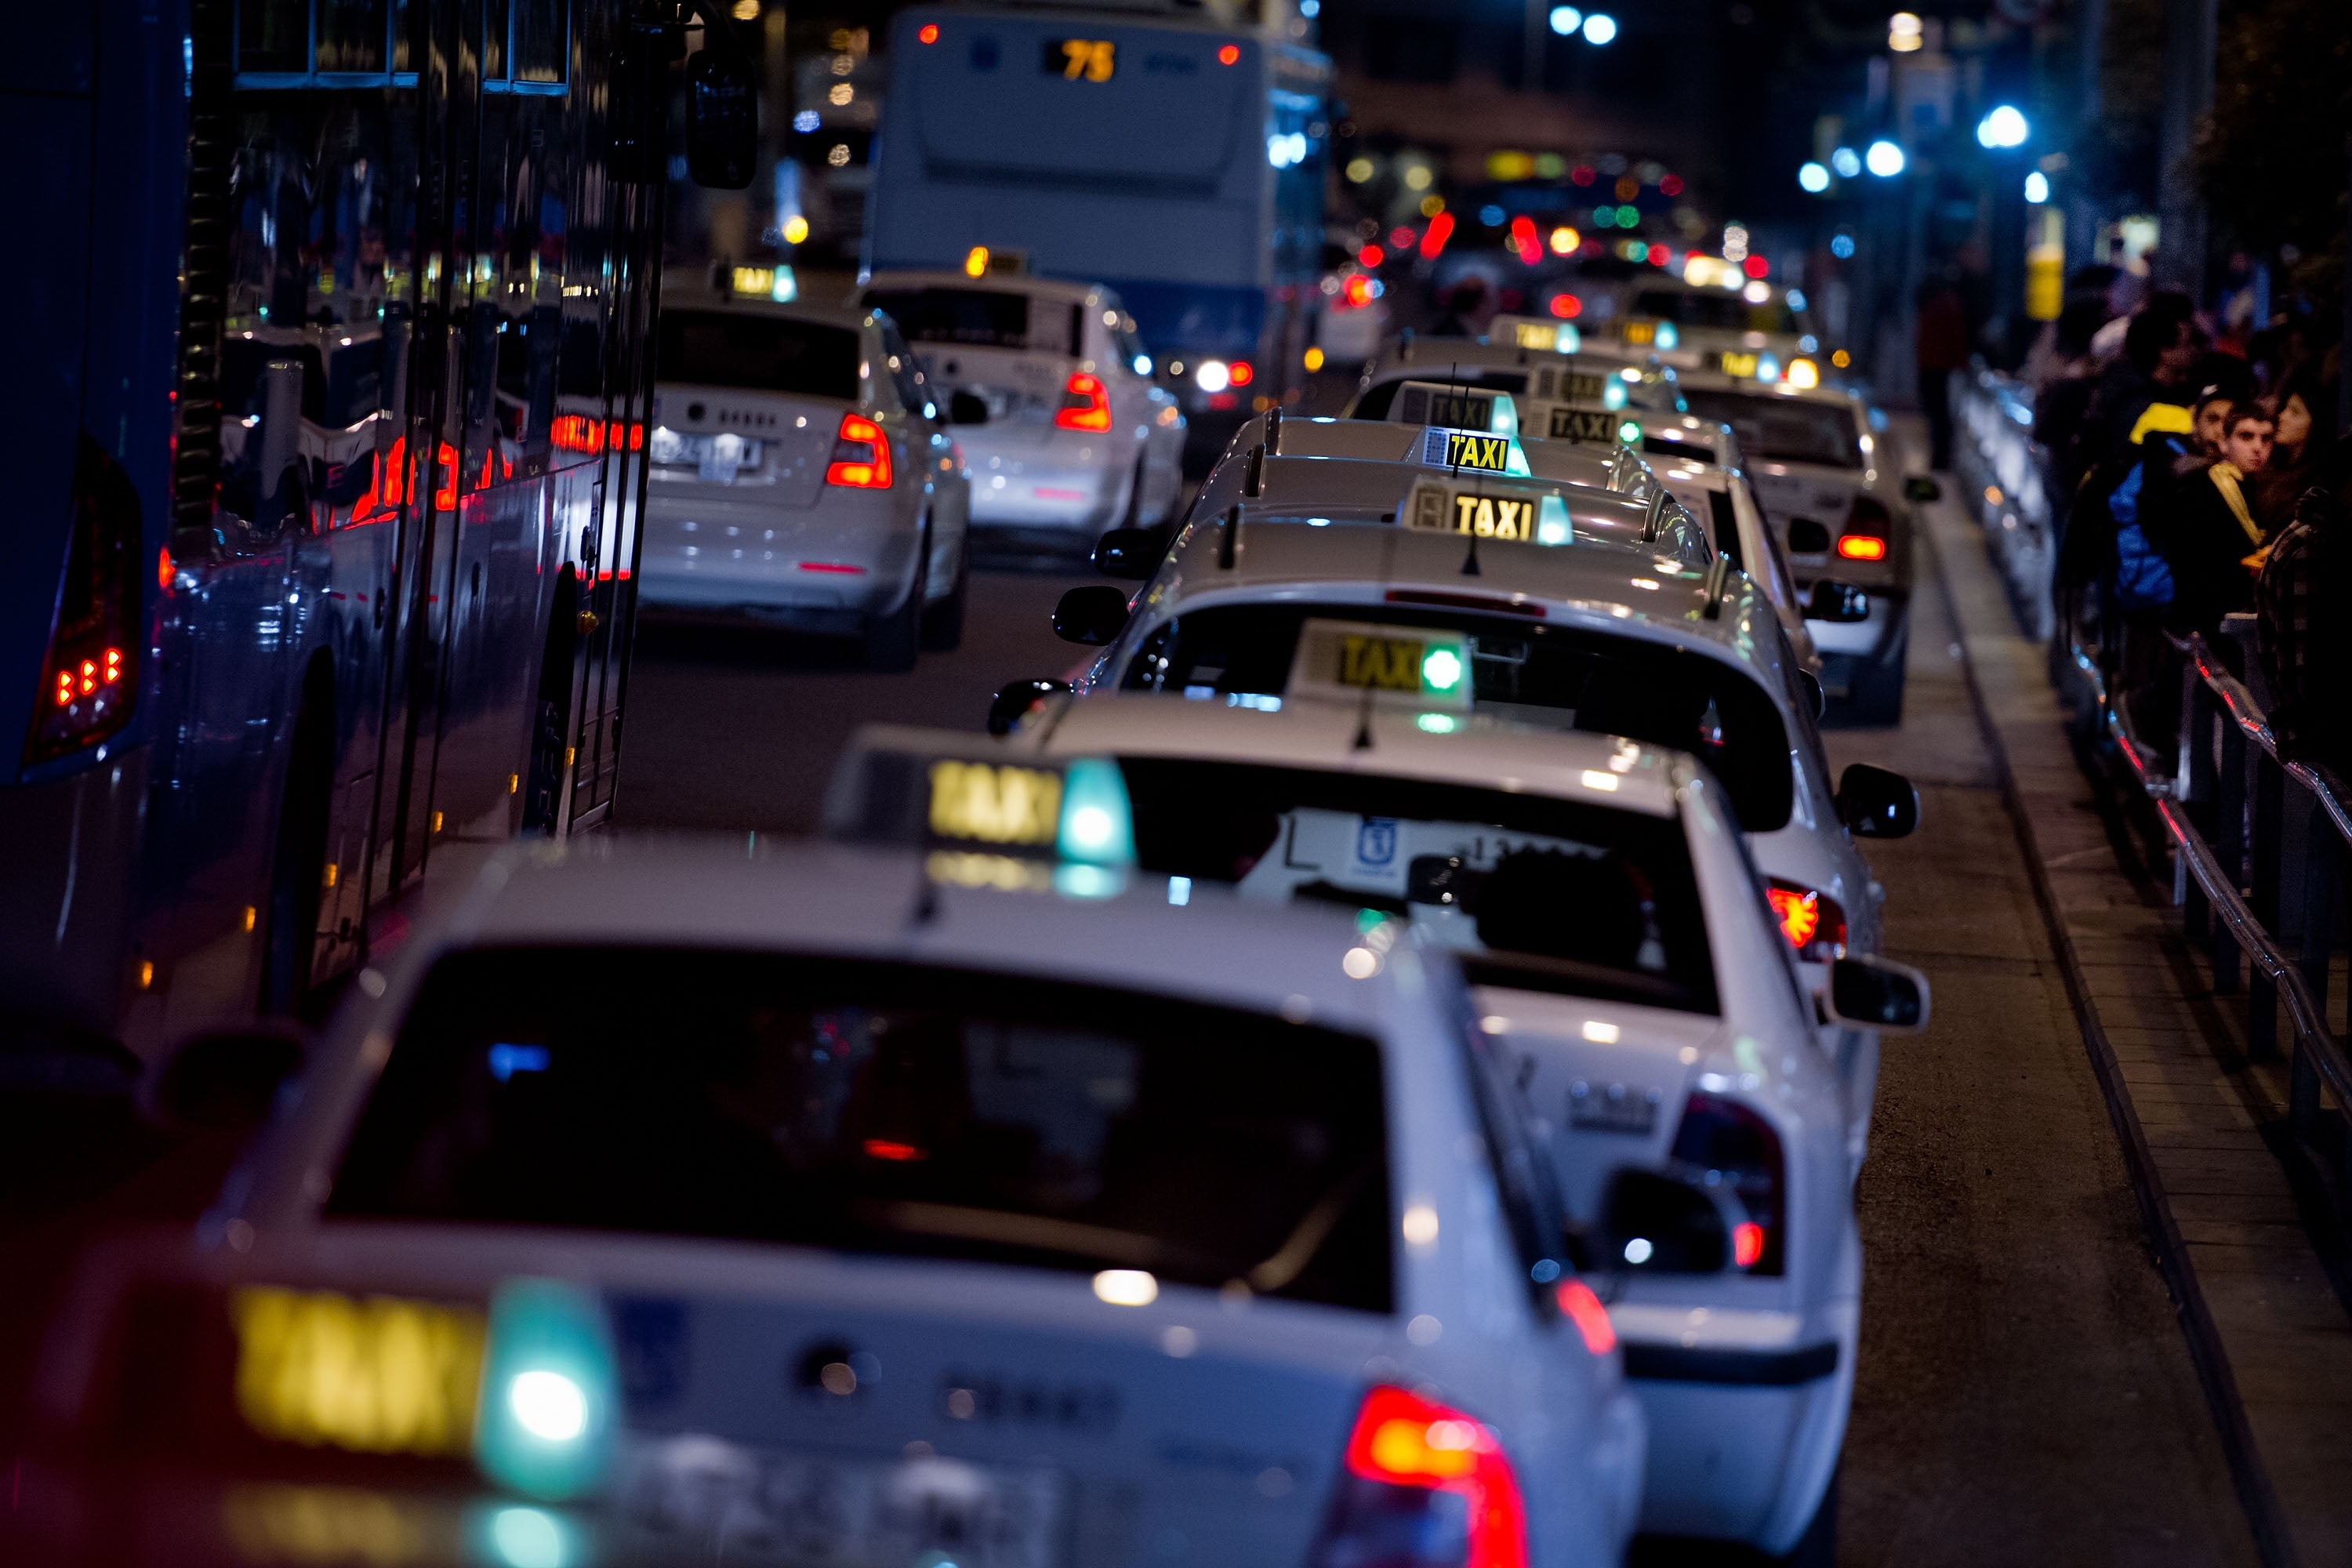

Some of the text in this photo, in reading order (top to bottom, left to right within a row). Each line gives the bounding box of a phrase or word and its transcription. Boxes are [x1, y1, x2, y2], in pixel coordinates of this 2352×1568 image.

[1436, 395, 1486, 429] TAXI
[1555, 411, 1615, 442] TAXI
[1450, 435, 1507, 470] TAXI
[1457, 495, 1534, 543] TAXI
